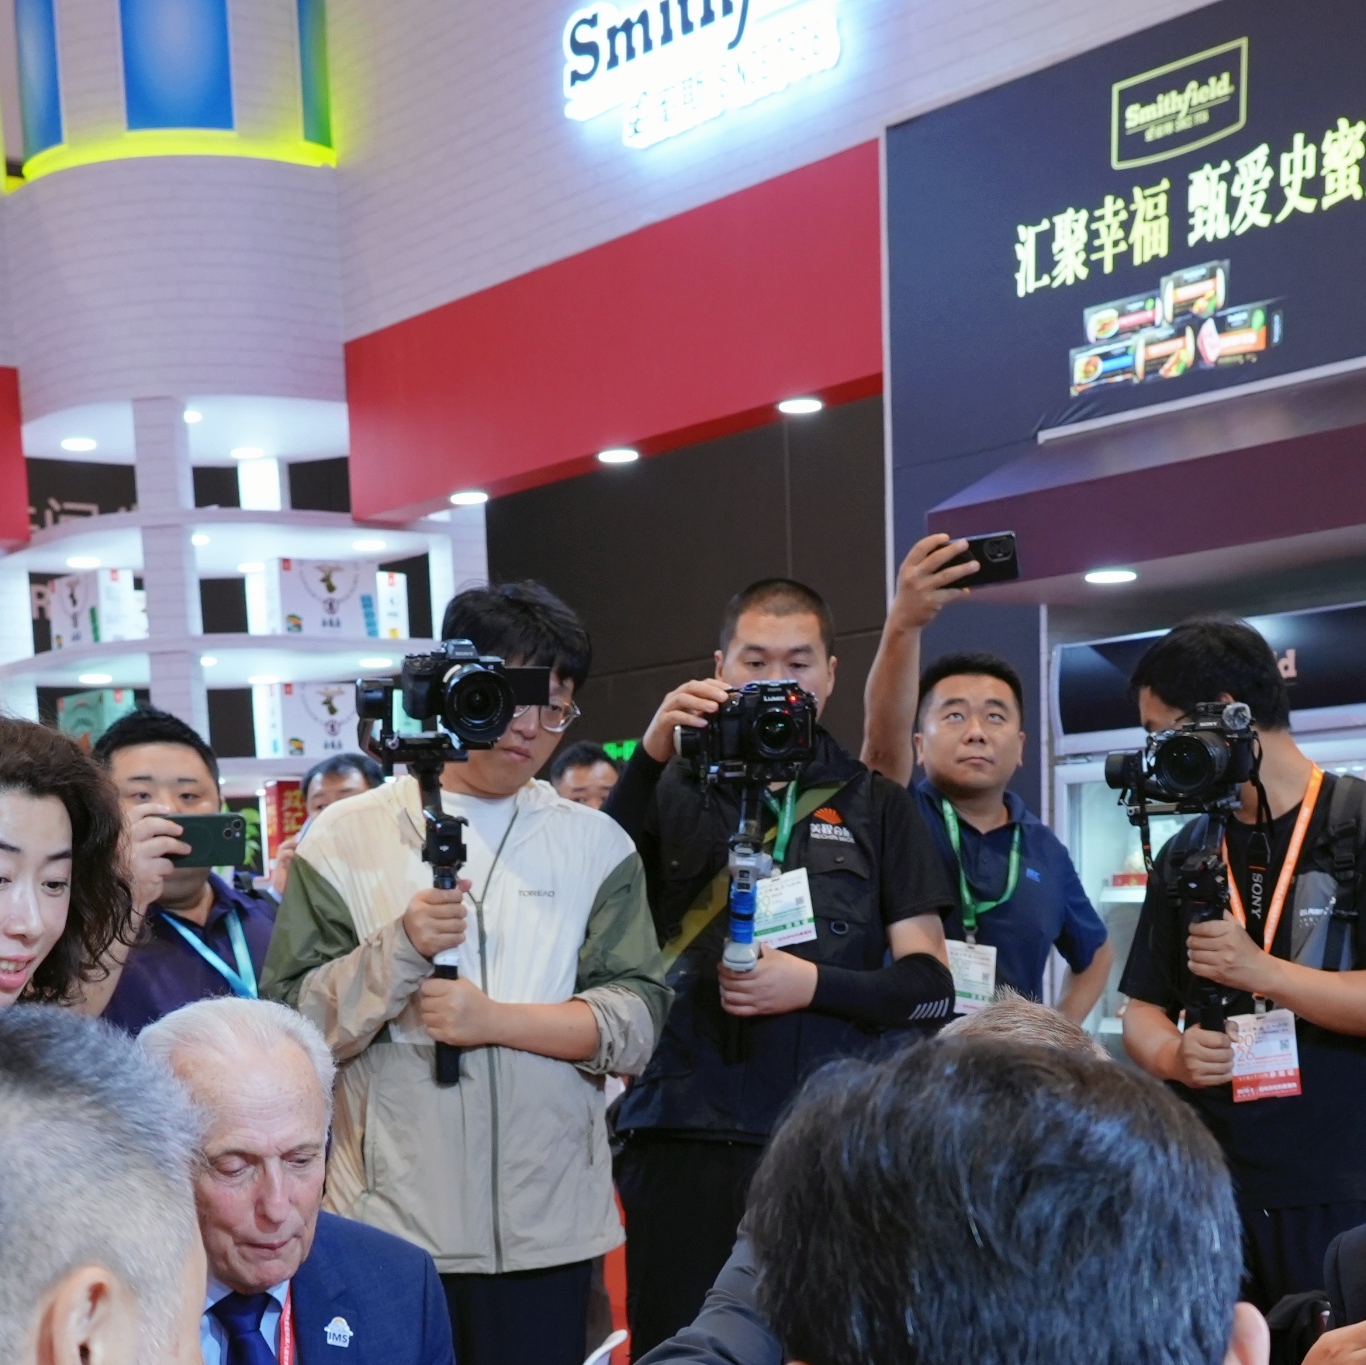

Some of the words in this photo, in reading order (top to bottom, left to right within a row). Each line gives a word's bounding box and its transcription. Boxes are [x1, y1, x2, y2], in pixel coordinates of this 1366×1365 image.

[1014, 178, 1171, 298] 汇聚幸福
[1250, 872, 1264, 920] SONY
[328, 1332, 349, 1344] IMS
